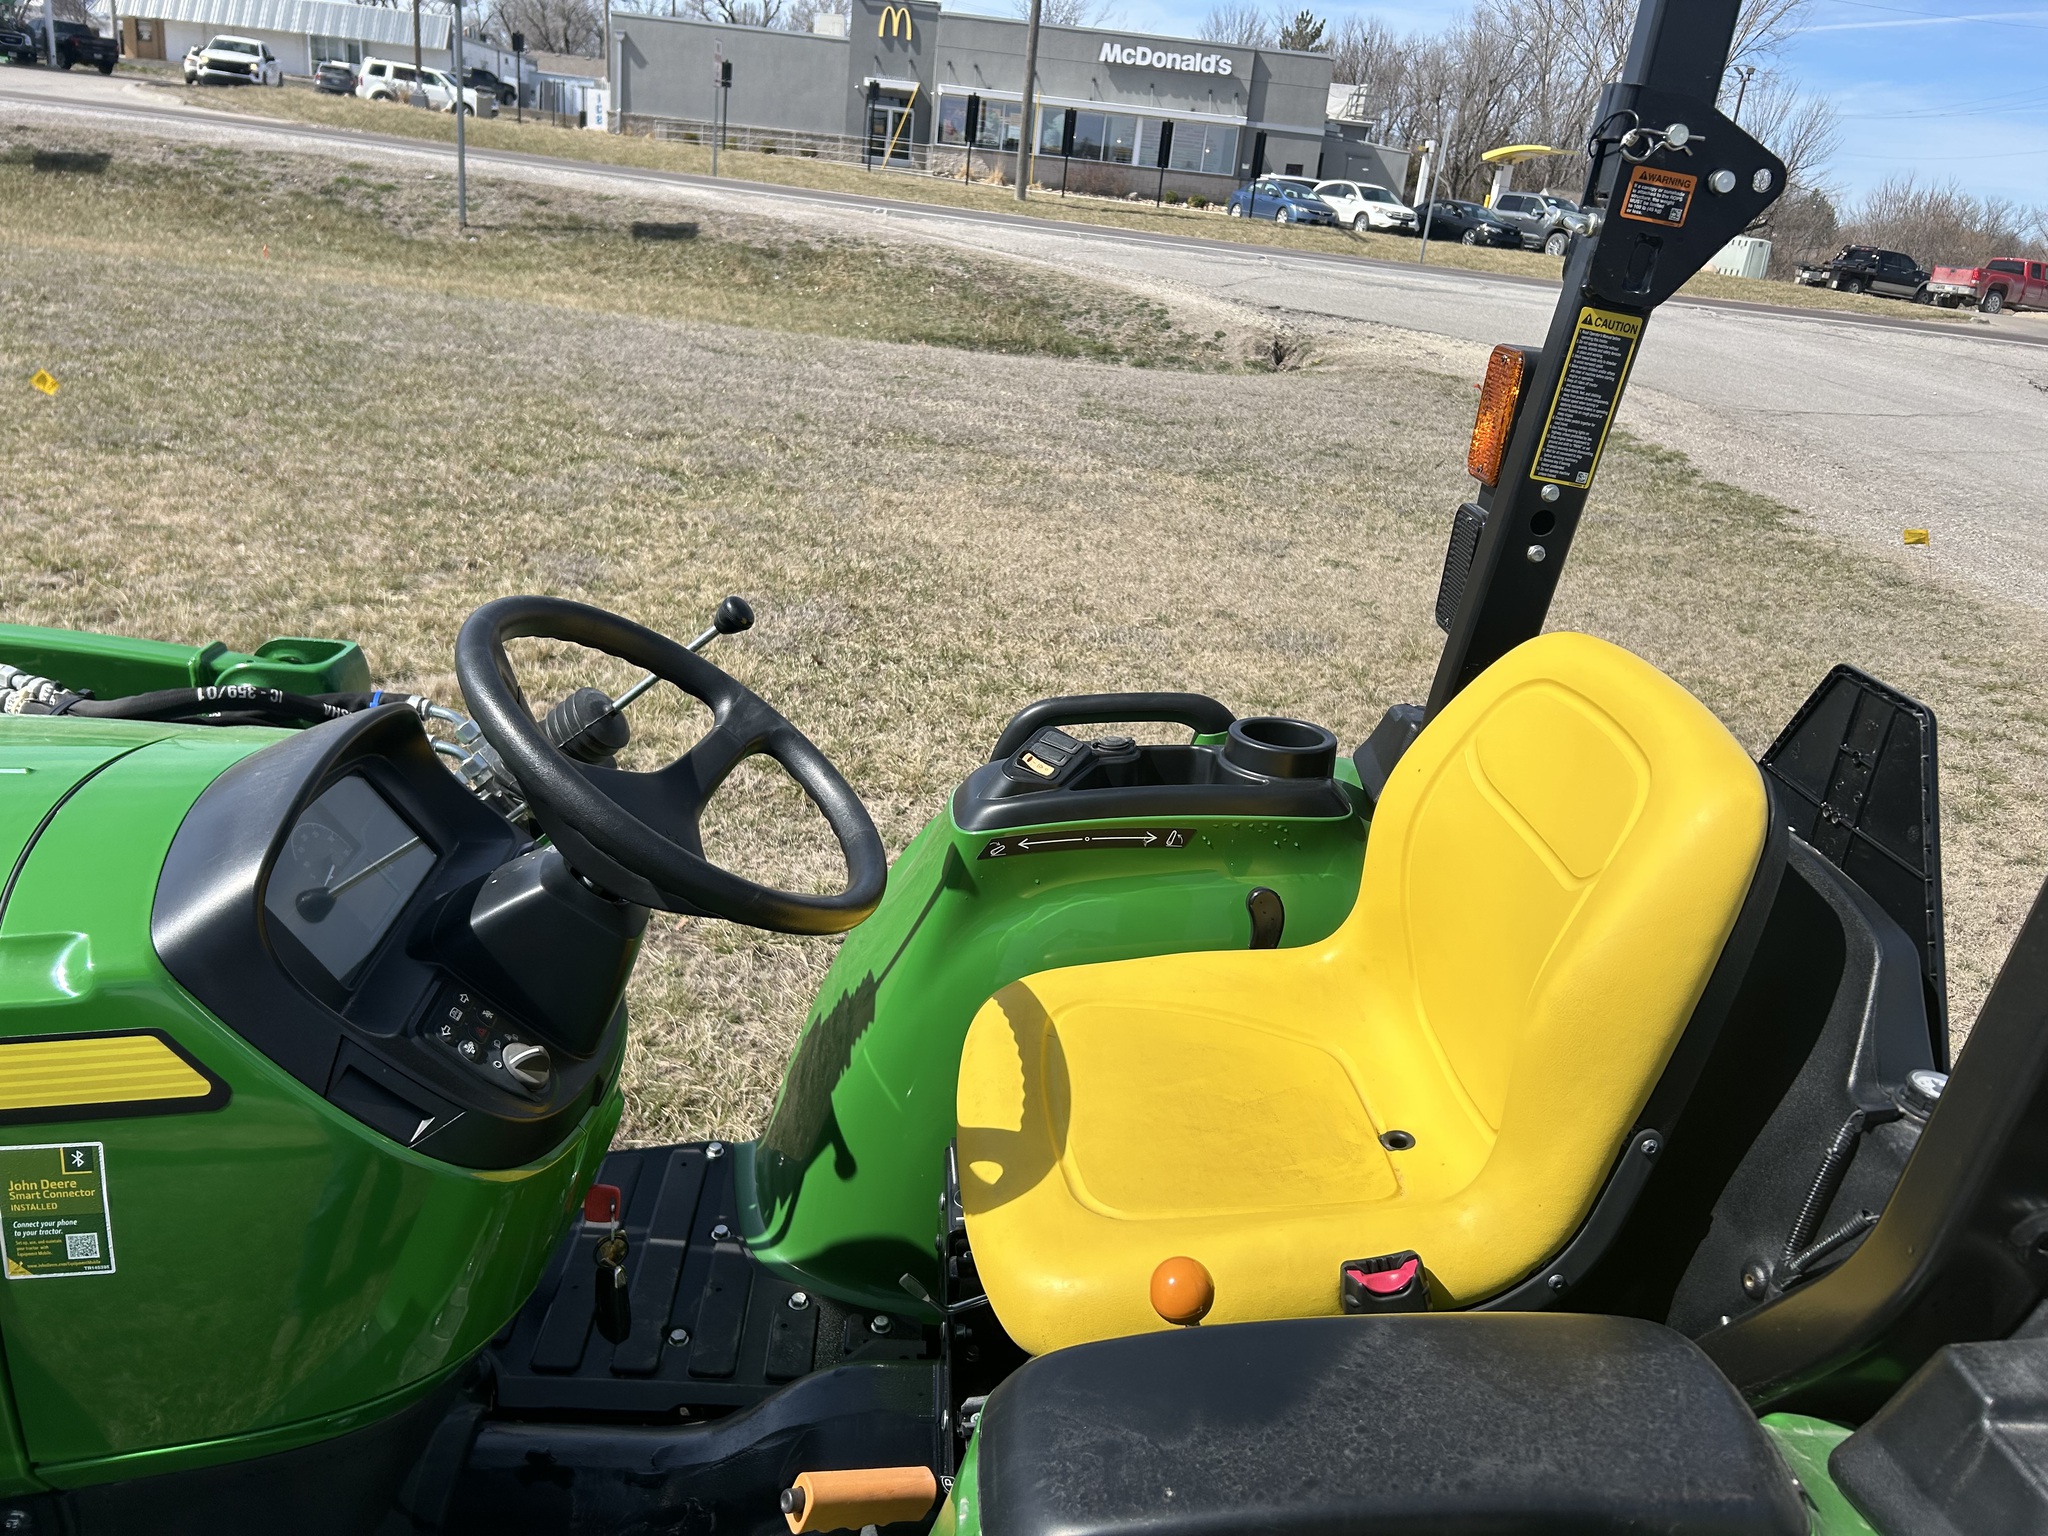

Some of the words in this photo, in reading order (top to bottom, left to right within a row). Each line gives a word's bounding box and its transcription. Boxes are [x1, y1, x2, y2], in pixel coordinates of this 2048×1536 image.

[1099, 42, 1232, 75] McDonald's
[1648, 172, 1691, 188] WARNING
[1594, 317, 1639, 335] CAUTION
[197, 683, 257, 702] 359/01
[8, 1180, 37, 1191] John
[41, 1179, 77, 1190] Deere
[9, 1191, 41, 1200] Smart
[43, 1189, 96, 1199] Connector
[11, 1202, 58, 1211] INSTALLED
[13, 1221, 39, 1229] Connect
[56, 1219, 78, 1227] phone
[22, 1230, 37, 1238] your
[39, 1228, 63, 1236] tractor.
